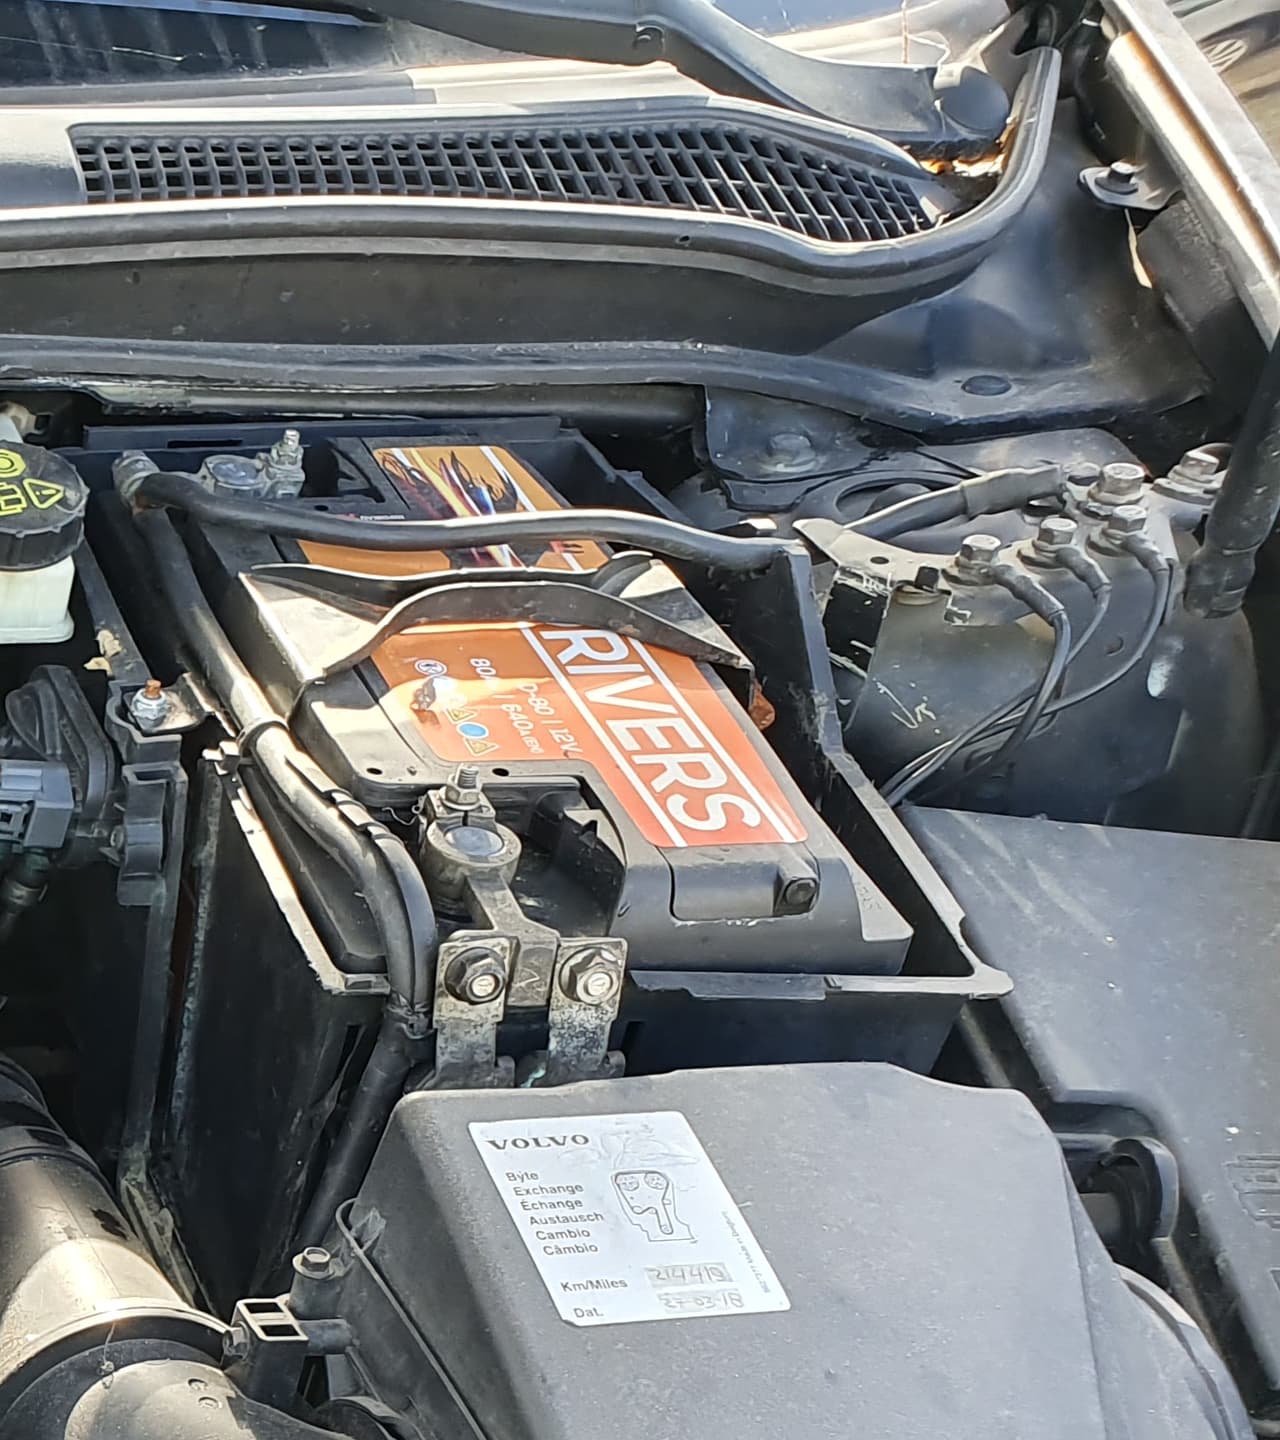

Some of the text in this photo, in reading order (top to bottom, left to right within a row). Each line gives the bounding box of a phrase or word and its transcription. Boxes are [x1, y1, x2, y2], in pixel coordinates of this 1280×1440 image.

[540, 623, 761, 831] RIVERS
[487, 1134, 590, 1151] VOLVO
[514, 1183, 584, 1197] Exchange
[520, 1199, 584, 1212] Échange
[529, 1212, 604, 1226] Austausch
[535, 1229, 591, 1241] Cambio
[560, 1278, 629, 1293] Km/Miles
